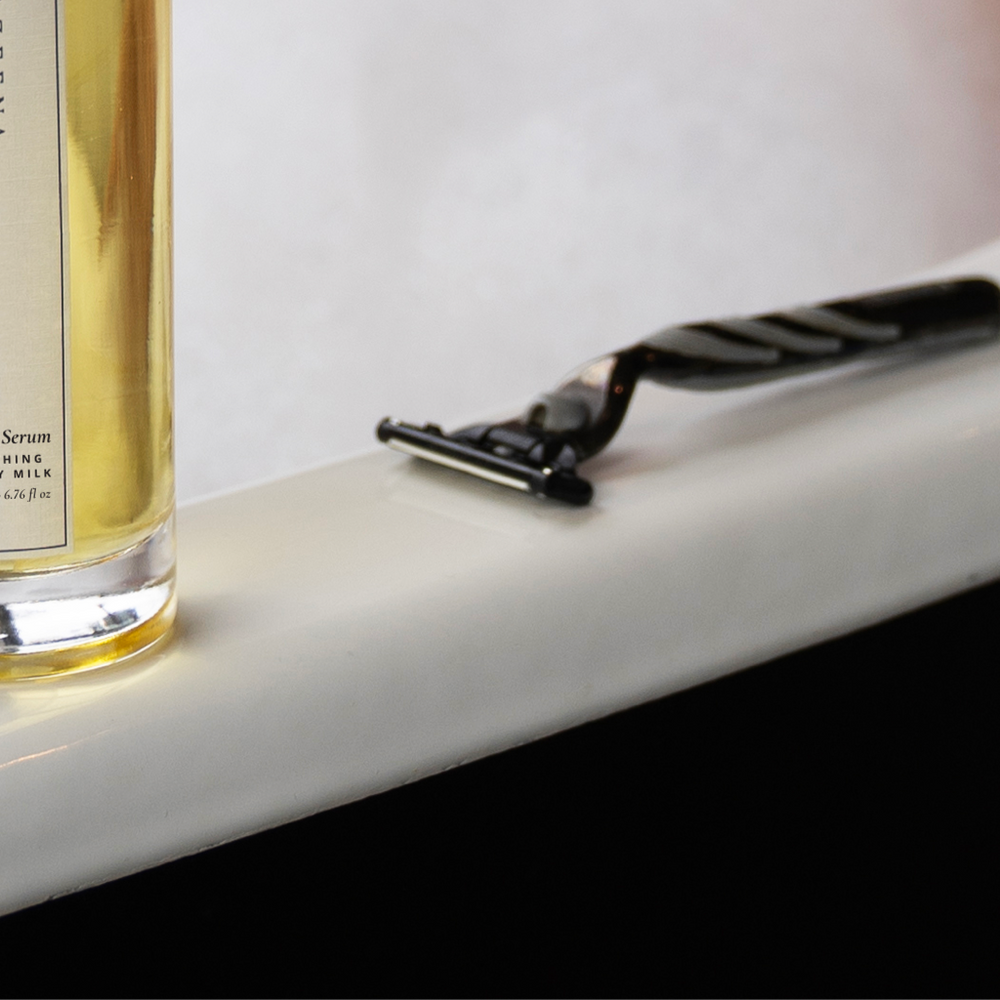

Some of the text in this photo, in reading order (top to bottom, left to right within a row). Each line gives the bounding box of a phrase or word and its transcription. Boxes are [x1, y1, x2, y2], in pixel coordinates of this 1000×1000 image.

[0, 429, 51, 445] Serum
[13, 468, 52, 479] MILK
[3, 488, 26, 500] 6.76
[26, 487, 37, 503] fl
[39, 491, 52, 499] oz
